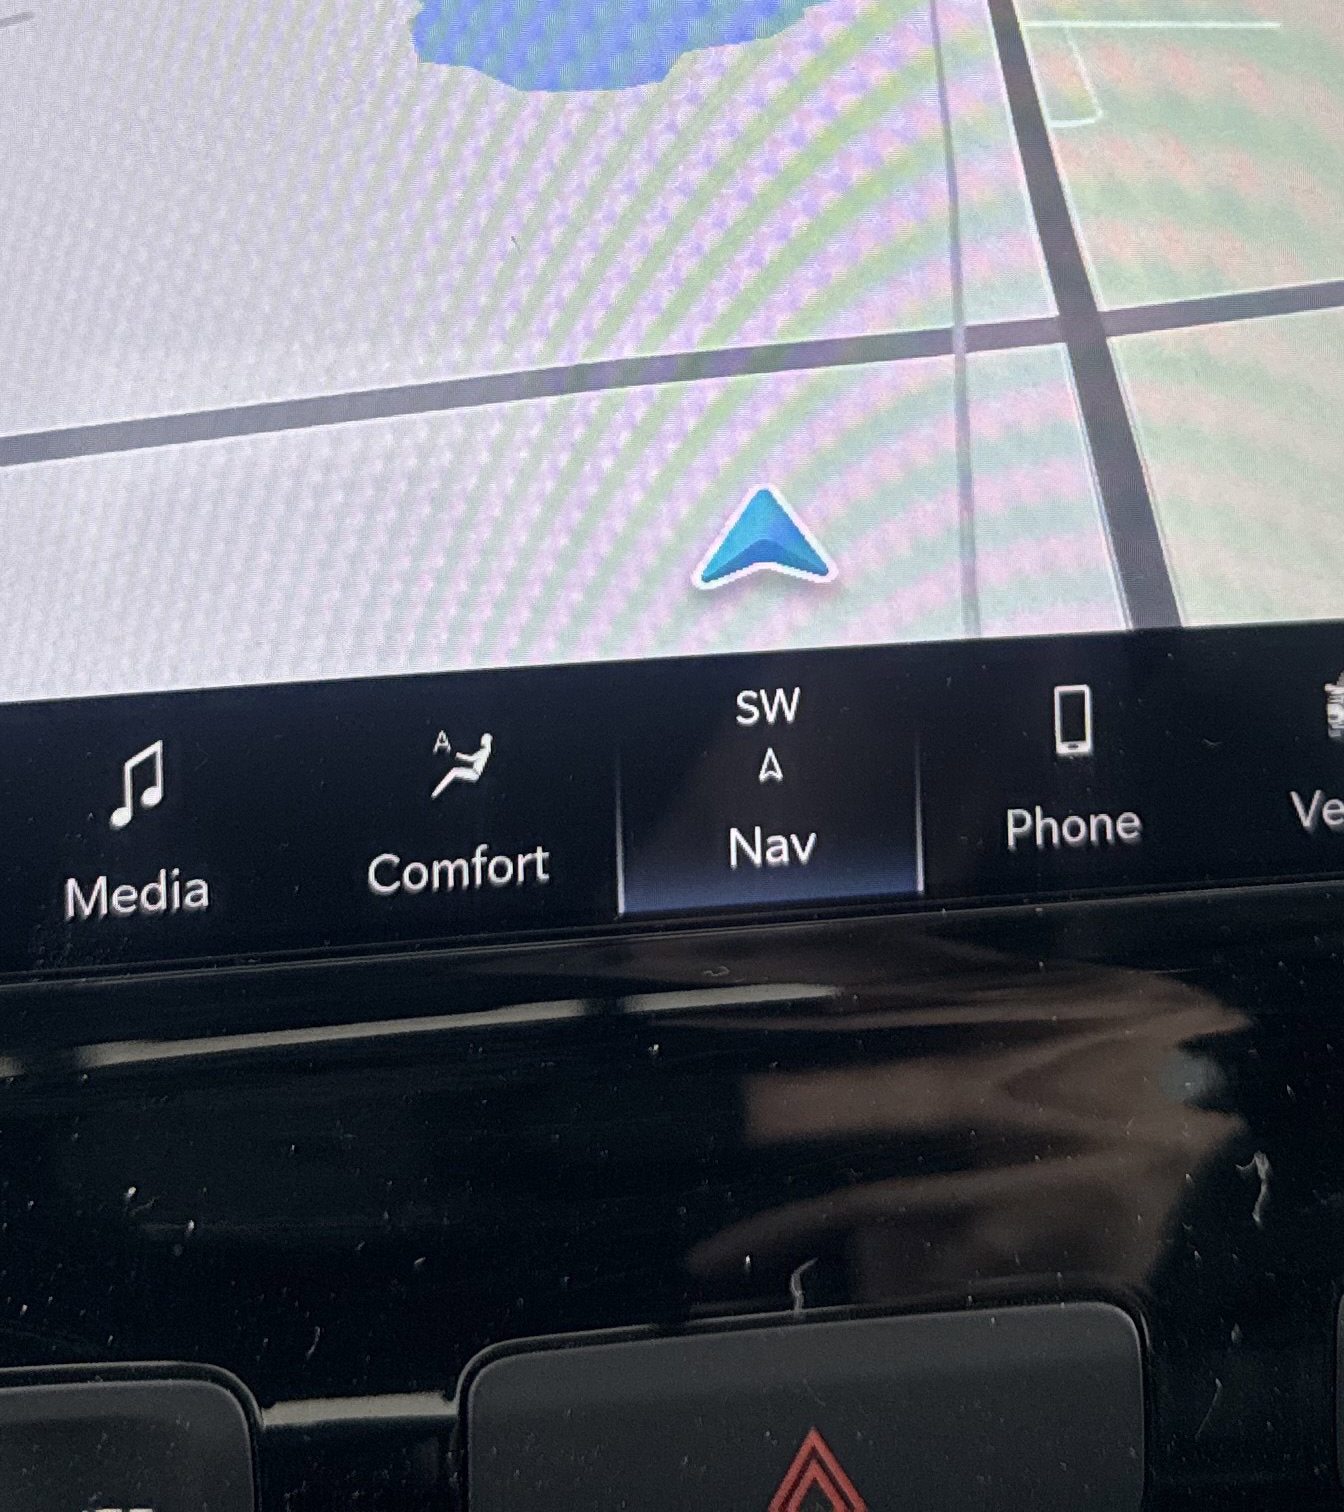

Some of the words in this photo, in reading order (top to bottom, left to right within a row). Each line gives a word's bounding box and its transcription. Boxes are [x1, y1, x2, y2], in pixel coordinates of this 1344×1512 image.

[736, 687, 800, 727] SW
[729, 827, 818, 870] Nav
[1006, 807, 1143, 851] Phone
[368, 844, 551, 894] Comfort
[64, 868, 210, 921] Media
